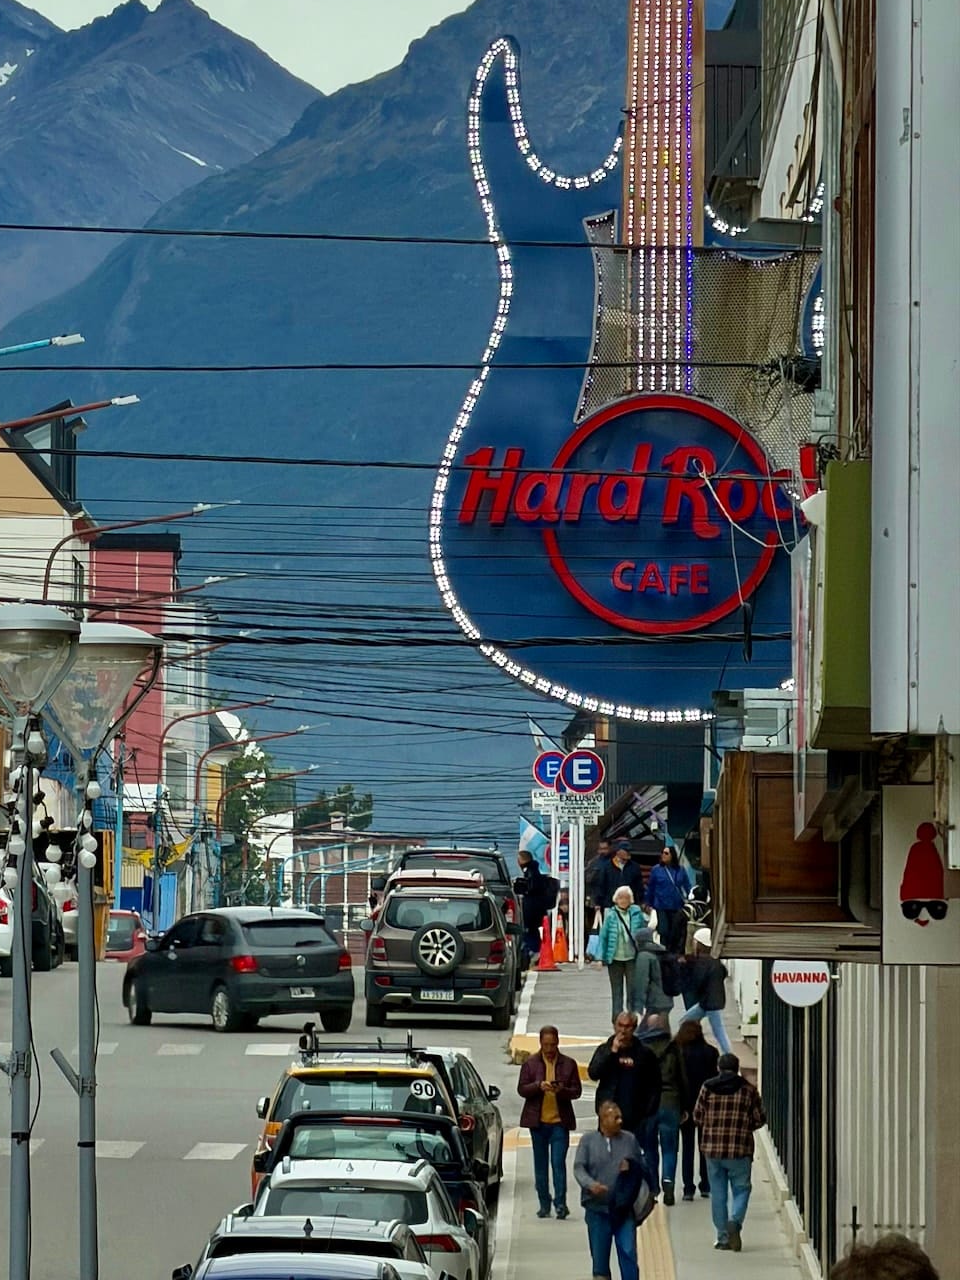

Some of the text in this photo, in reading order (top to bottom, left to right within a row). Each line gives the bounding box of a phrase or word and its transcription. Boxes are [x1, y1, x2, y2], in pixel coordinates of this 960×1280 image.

[458, 444, 652, 526] Hard
[611, 560, 710, 595] CAFE
[547, 761, 559, 777] E
[573, 759, 592, 784] E
[559, 794, 603, 802] EXCLUSIVO
[773, 972, 828, 983] HAVANNA
[413, 1082, 434, 1097] 90
